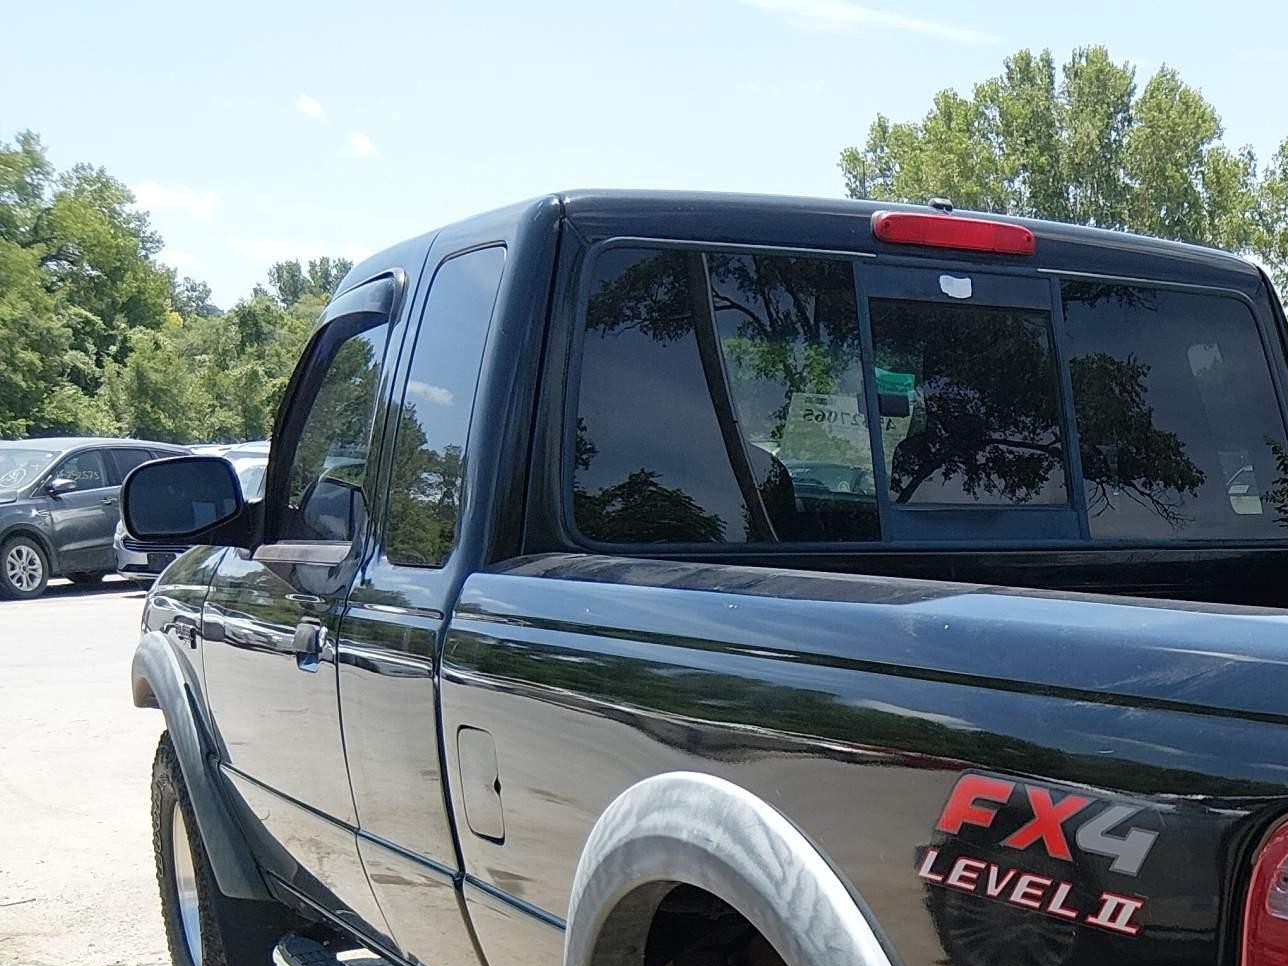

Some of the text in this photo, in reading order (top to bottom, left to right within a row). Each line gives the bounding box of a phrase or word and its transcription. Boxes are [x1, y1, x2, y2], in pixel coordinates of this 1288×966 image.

[936, 773, 1160, 877] FX4
[917, 848, 1146, 938] LEVEL II
